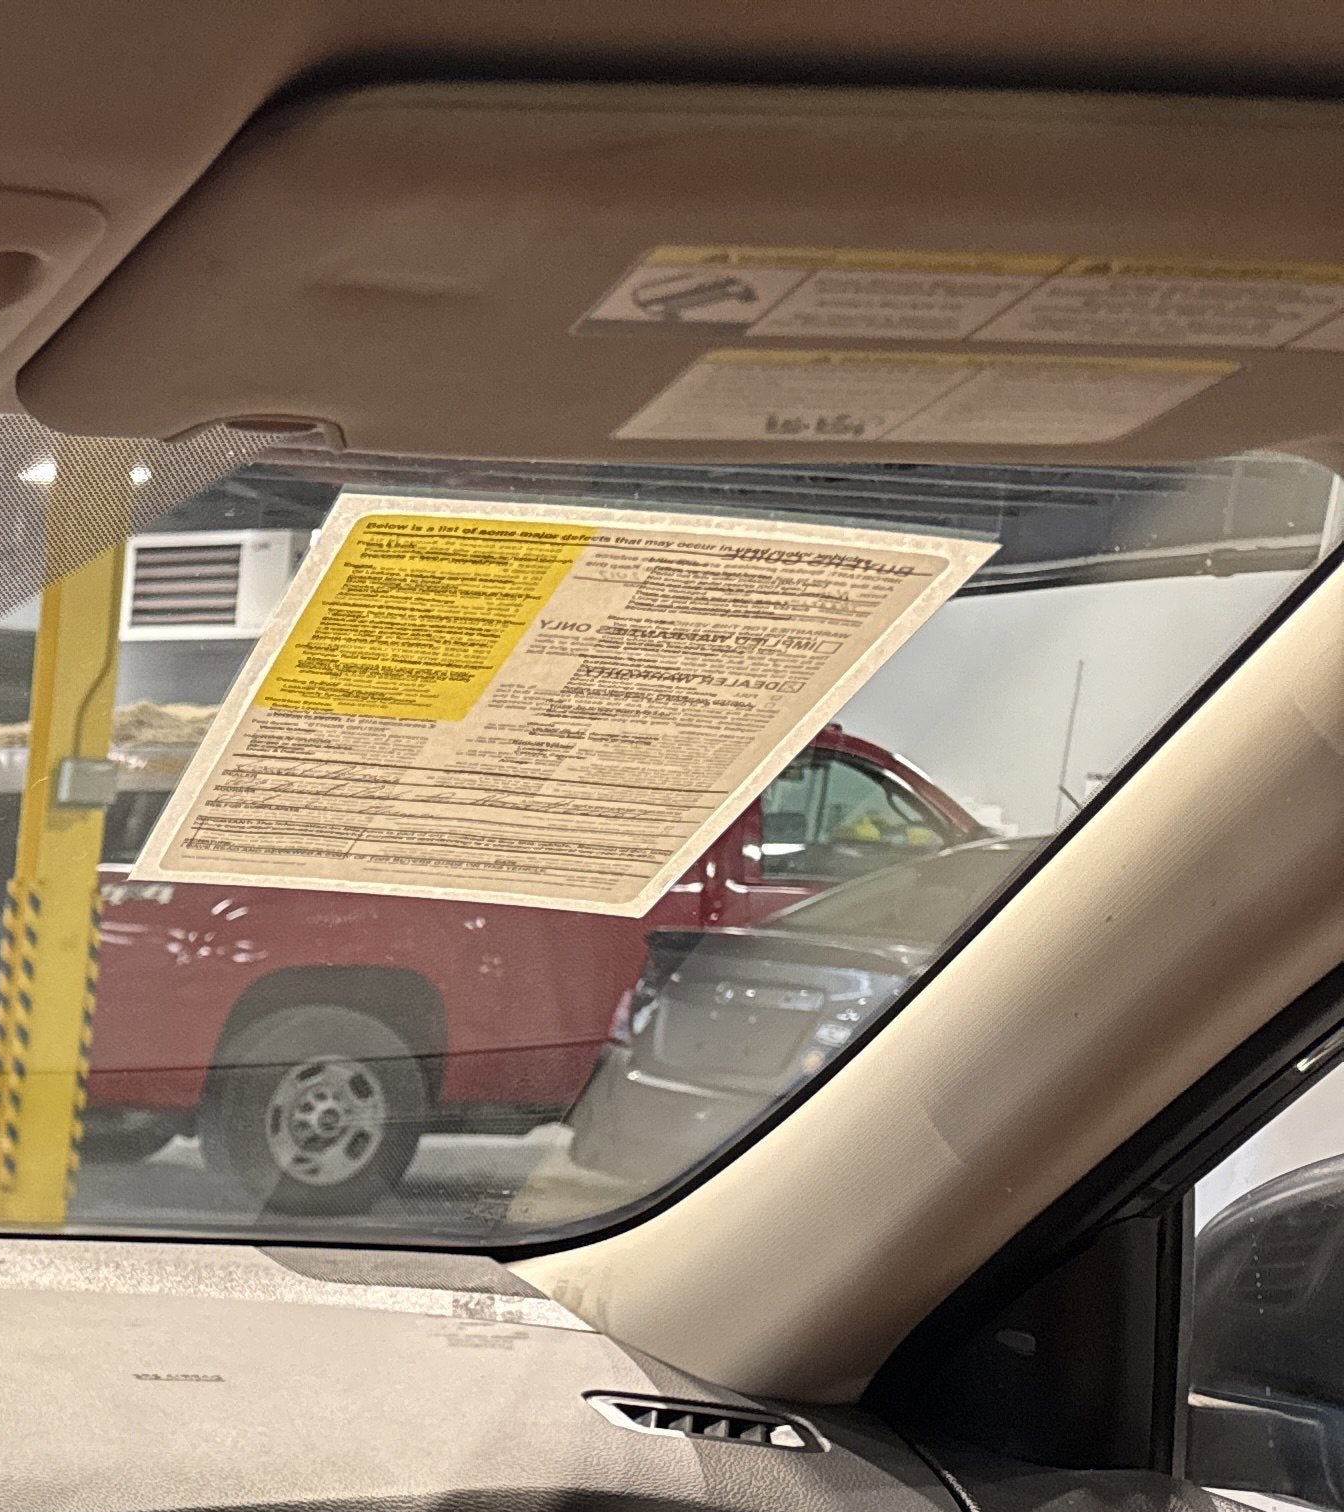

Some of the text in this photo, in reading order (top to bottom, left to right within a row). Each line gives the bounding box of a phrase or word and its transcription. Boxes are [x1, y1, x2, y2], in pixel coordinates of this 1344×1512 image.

[366, 521, 409, 531] Below
[411, 523, 423, 532] is
[519, 530, 559, 541] major
[562, 533, 611, 543] defects
[614, 535, 642, 545] that
[644, 538, 674, 549] may
[676, 541, 718, 551] occur
